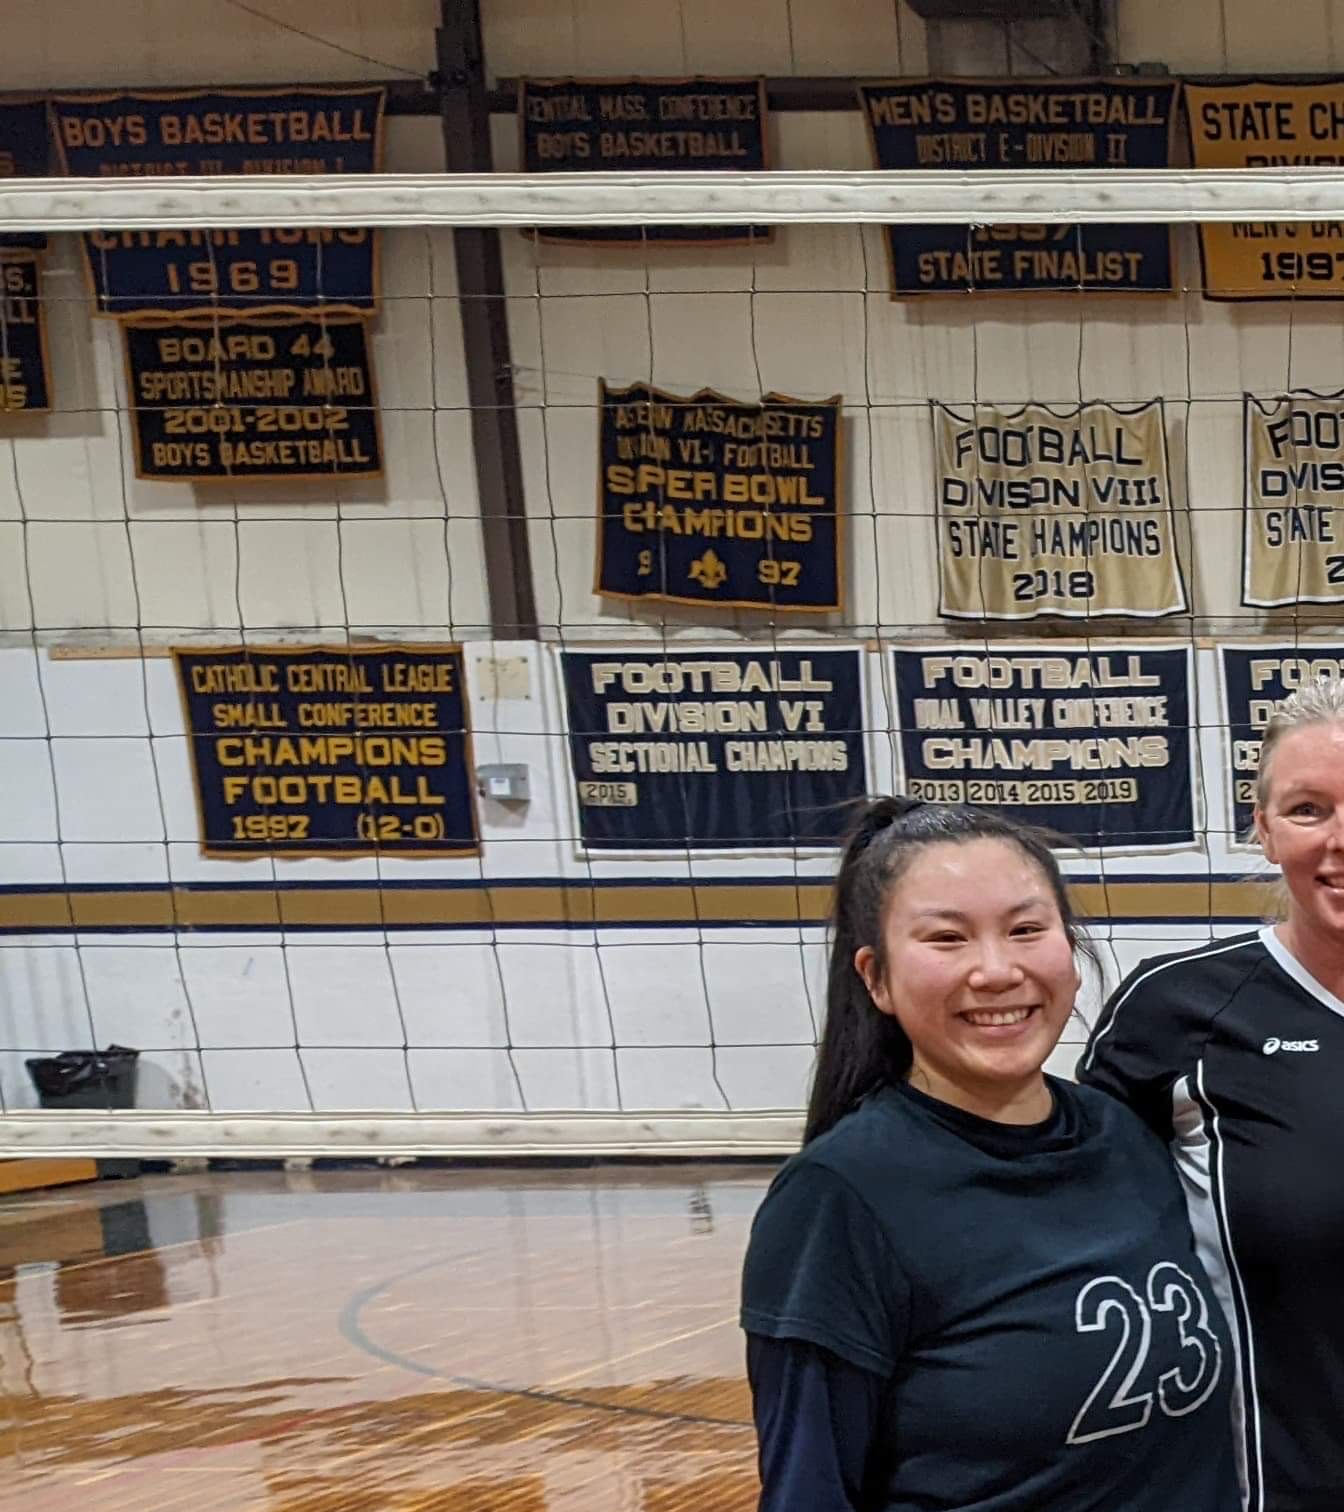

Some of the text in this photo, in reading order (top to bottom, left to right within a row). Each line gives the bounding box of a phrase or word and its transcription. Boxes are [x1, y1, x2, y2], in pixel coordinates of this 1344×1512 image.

[870, 90, 1165, 127] MEN'S BASKETBALL
[1201, 101, 1297, 142] STATE
[63, 109, 372, 147] BOYS BASKETBALL
[601, 131, 748, 158] BASKETBALL
[916, 132, 987, 164] DISTRICT
[1107, 133, 1129, 164] II
[166, 259, 299, 293] 1969
[917, 250, 1144, 284] STATE FINALIST
[158, 333, 335, 363] BOARD 44
[140, 367, 363, 400] SPORTSMANSHIP AWARD
[164, 407, 350, 434] 2001-2002
[153, 439, 370, 468] BOYS BASKETBALL
[606, 464, 826, 506] SPER BOWL
[1092, 476, 1162, 507] VIII
[949, 517, 1162, 560] STATE HAMPIONS
[758, 559, 803, 587] 97
[1012, 569, 1095, 601] 2018
[191, 663, 454, 693] CATHOLIC CENTRAL LEAGUE
[591, 660, 833, 694] FOOTBALL
[921, 655, 1161, 689] FOOTBALL
[212, 703, 440, 728] SMALL CONFERENCE
[606, 700, 825, 734] DIVISION VI
[969, 698, 1046, 730] VALLEY
[1053, 696, 1170, 729] CONFERENCE
[216, 736, 447, 767] CHAMPIONS
[589, 740, 848, 774] SECTIONAL CHAMPIONS
[922, 735, 1170, 771] CHAMPIONS
[222, 775, 446, 805] FOOTBALL
[586, 783, 628, 800] 2015
[911, 781, 1133, 802] 2013 2014 2015 2019
[233, 812, 445, 841] 1997 (12-0)
[1065, 1261, 1222, 1445] 23
